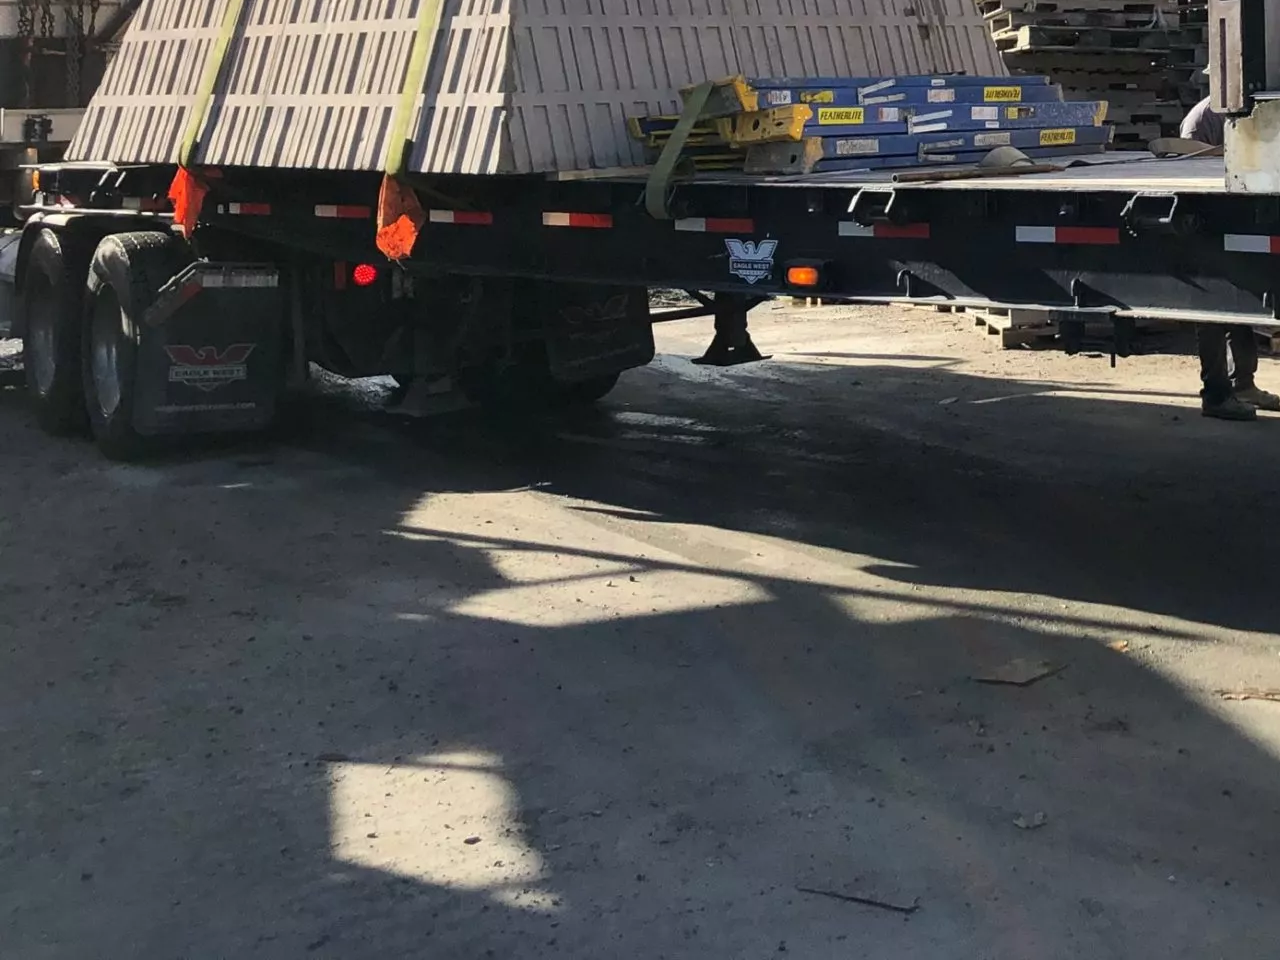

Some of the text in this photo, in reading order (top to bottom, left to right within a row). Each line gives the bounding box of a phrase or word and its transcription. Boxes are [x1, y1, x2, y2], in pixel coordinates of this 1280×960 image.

[985, 88, 1020, 100] FEATHERLITE
[820, 111, 862, 121] FEATHERLITE
[1041, 131, 1074, 144] FEATHERLITE
